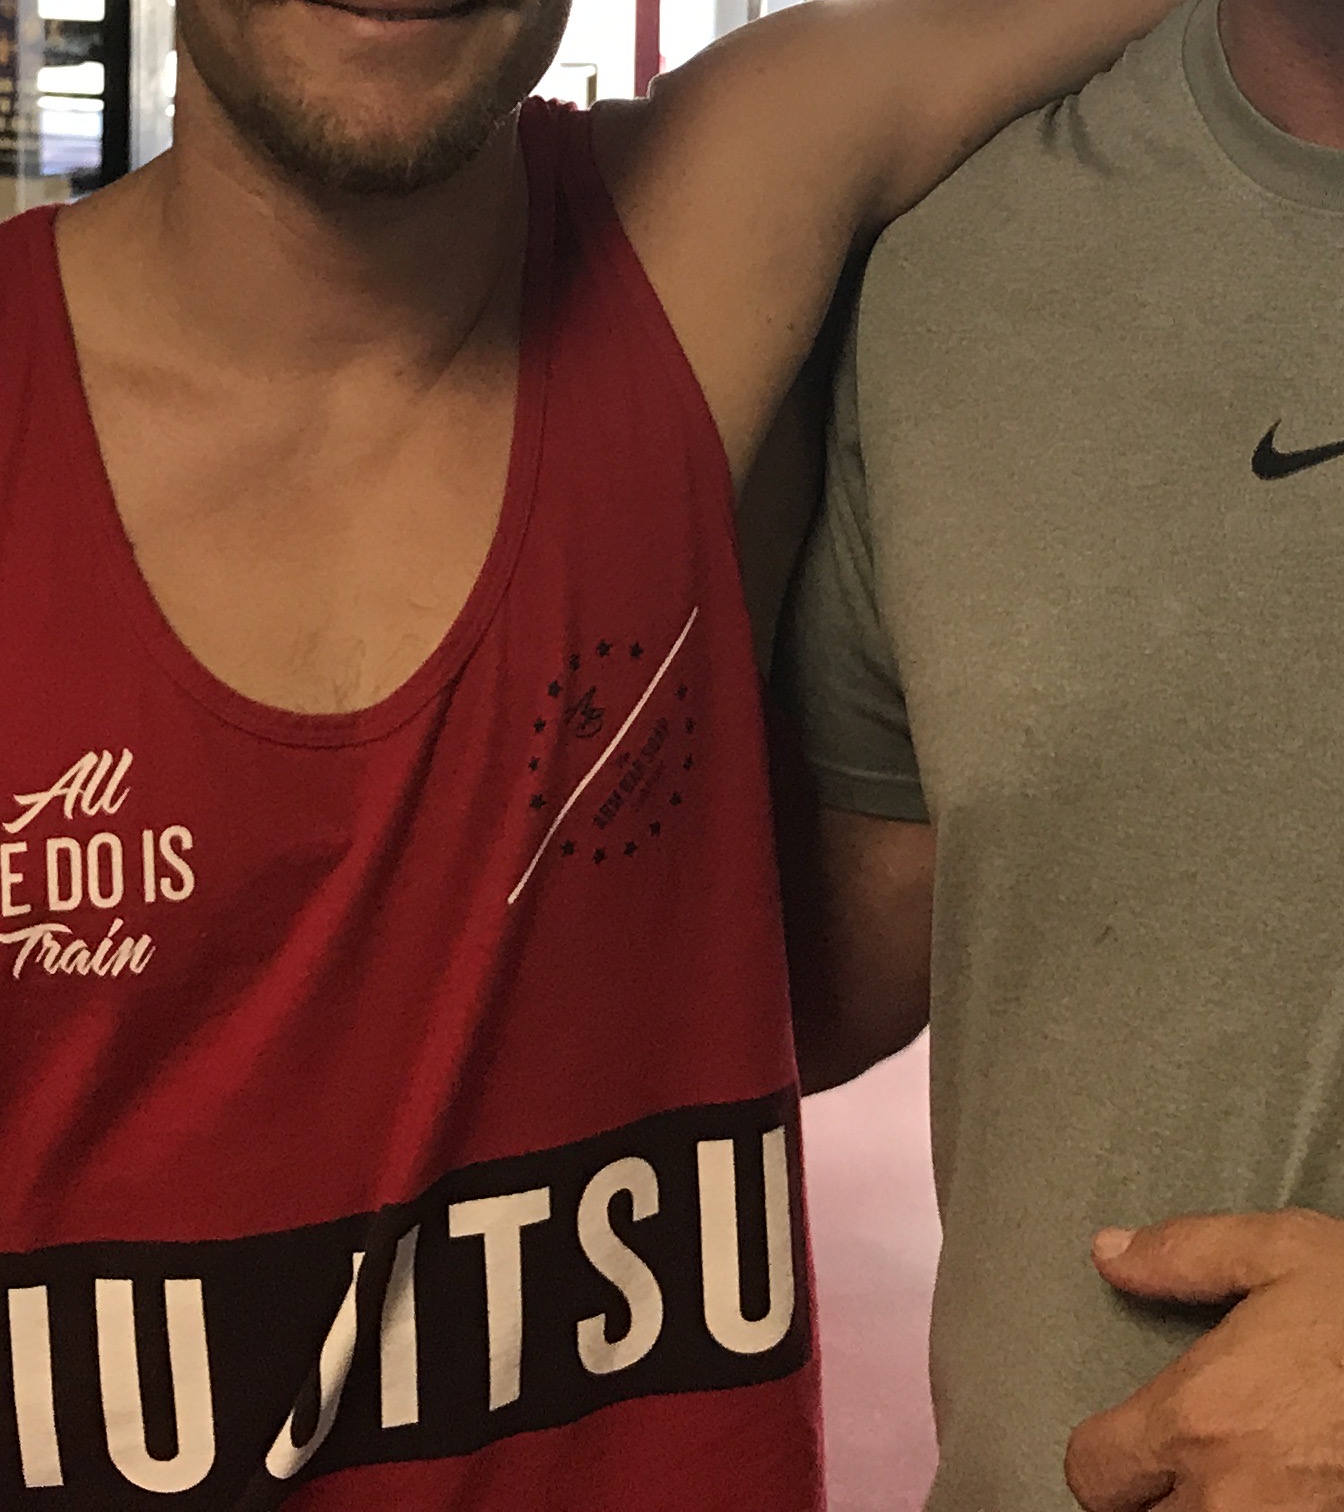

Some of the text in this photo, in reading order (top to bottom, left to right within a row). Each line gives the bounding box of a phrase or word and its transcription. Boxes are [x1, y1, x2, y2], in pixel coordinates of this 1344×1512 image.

[1, 747, 134, 834] All
[46, 831, 124, 912] DO
[141, 825, 196, 903] IS
[264, 1125, 795, 1480] JITSU
